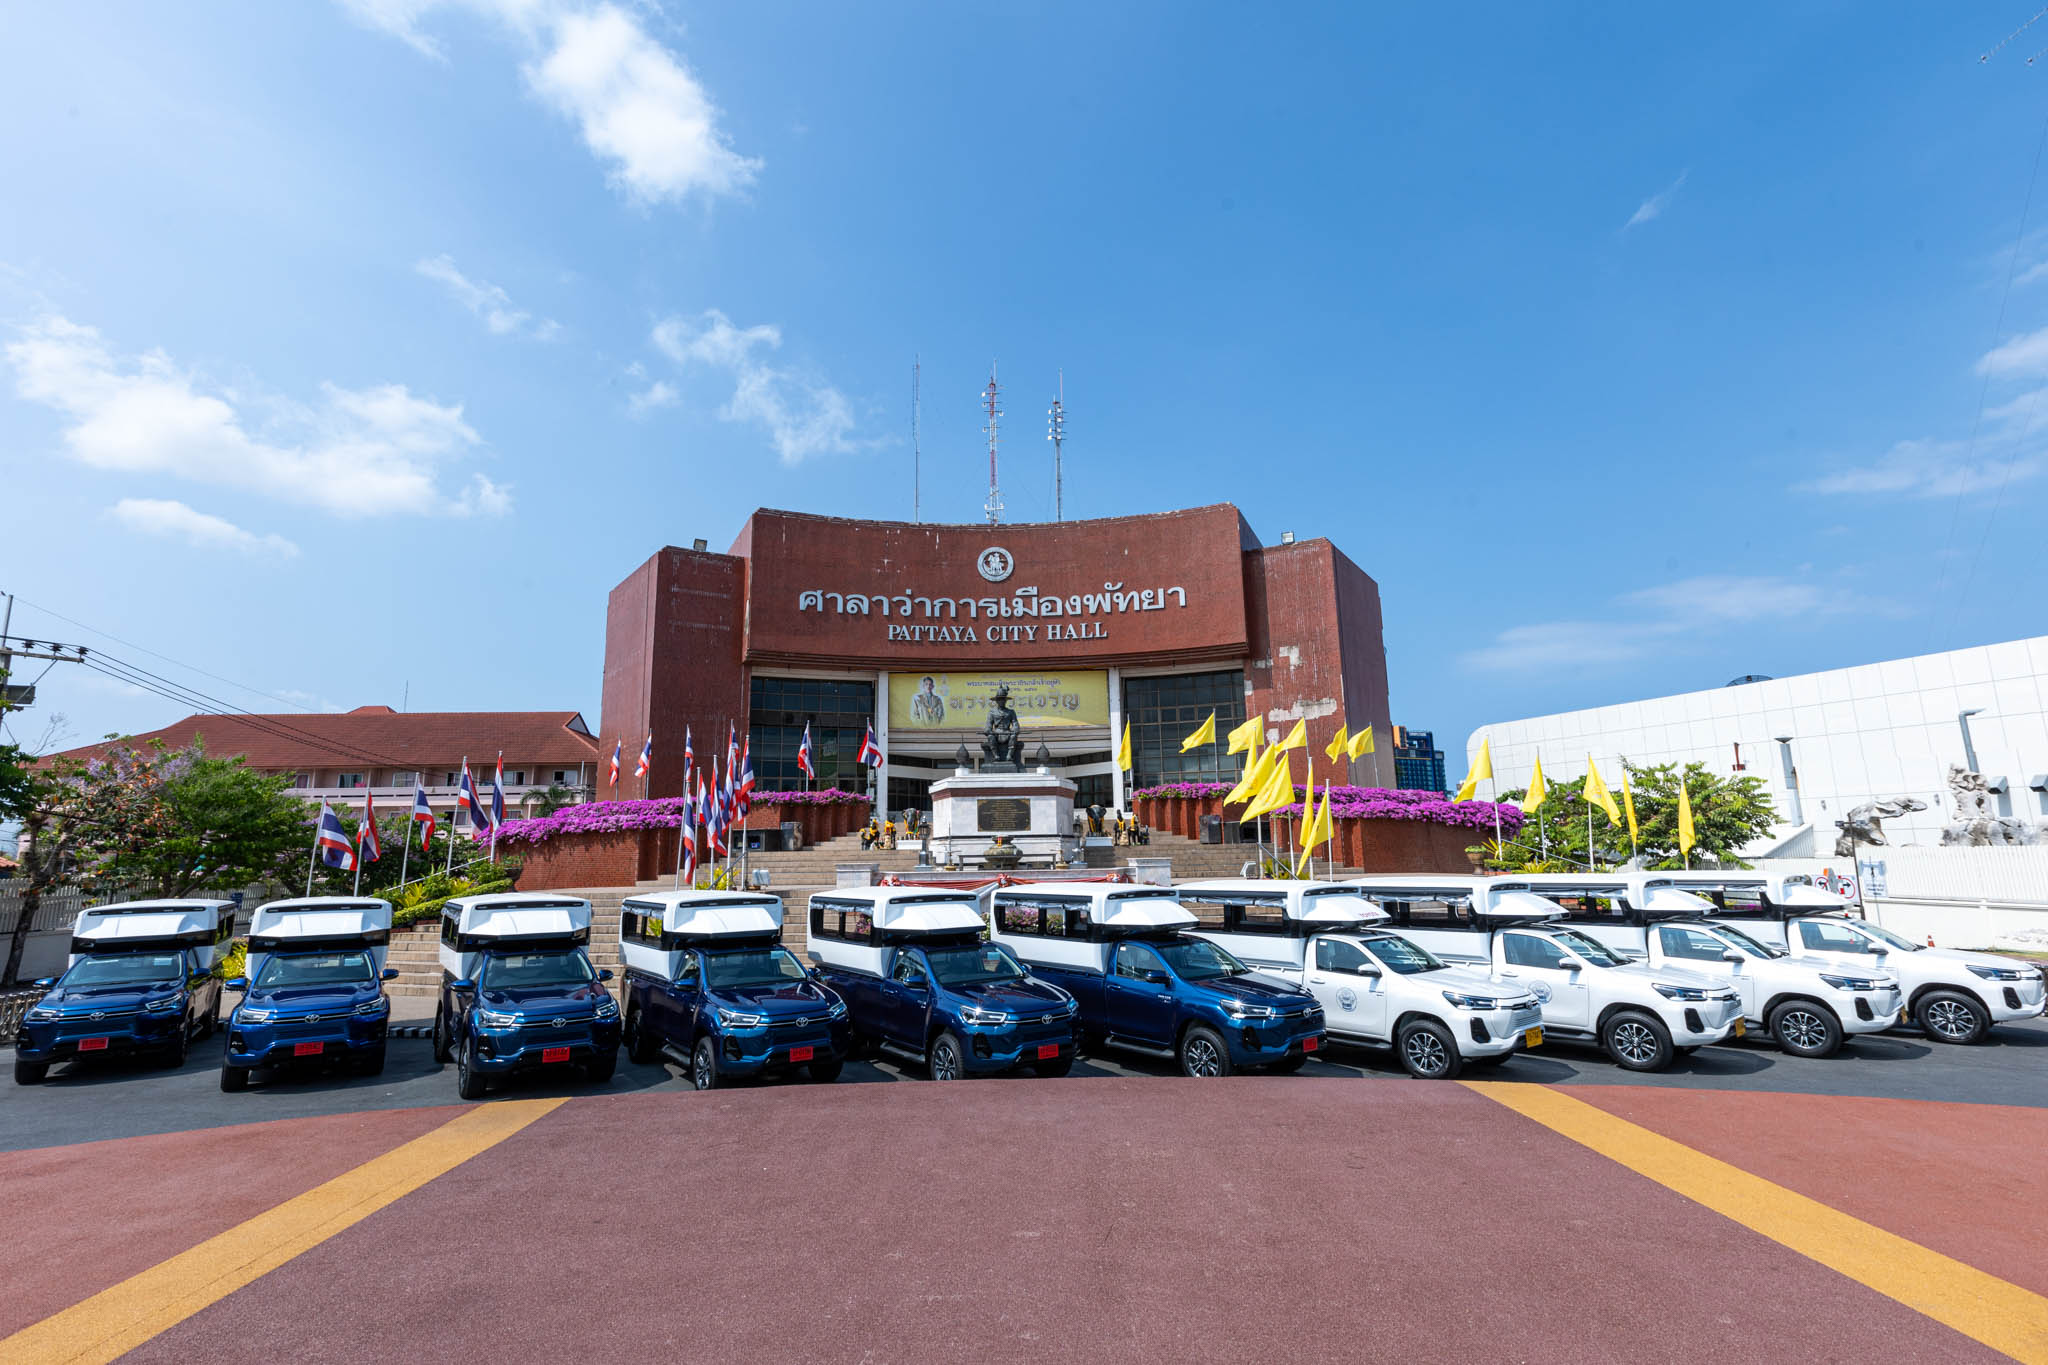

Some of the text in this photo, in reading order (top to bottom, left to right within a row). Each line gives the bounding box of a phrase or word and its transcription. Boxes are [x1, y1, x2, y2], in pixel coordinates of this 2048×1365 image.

[799, 581, 1187, 618] ศาลาว่าการเมืองพัทยา
[887, 622, 1108, 642] PATTAYA CITY HALL
